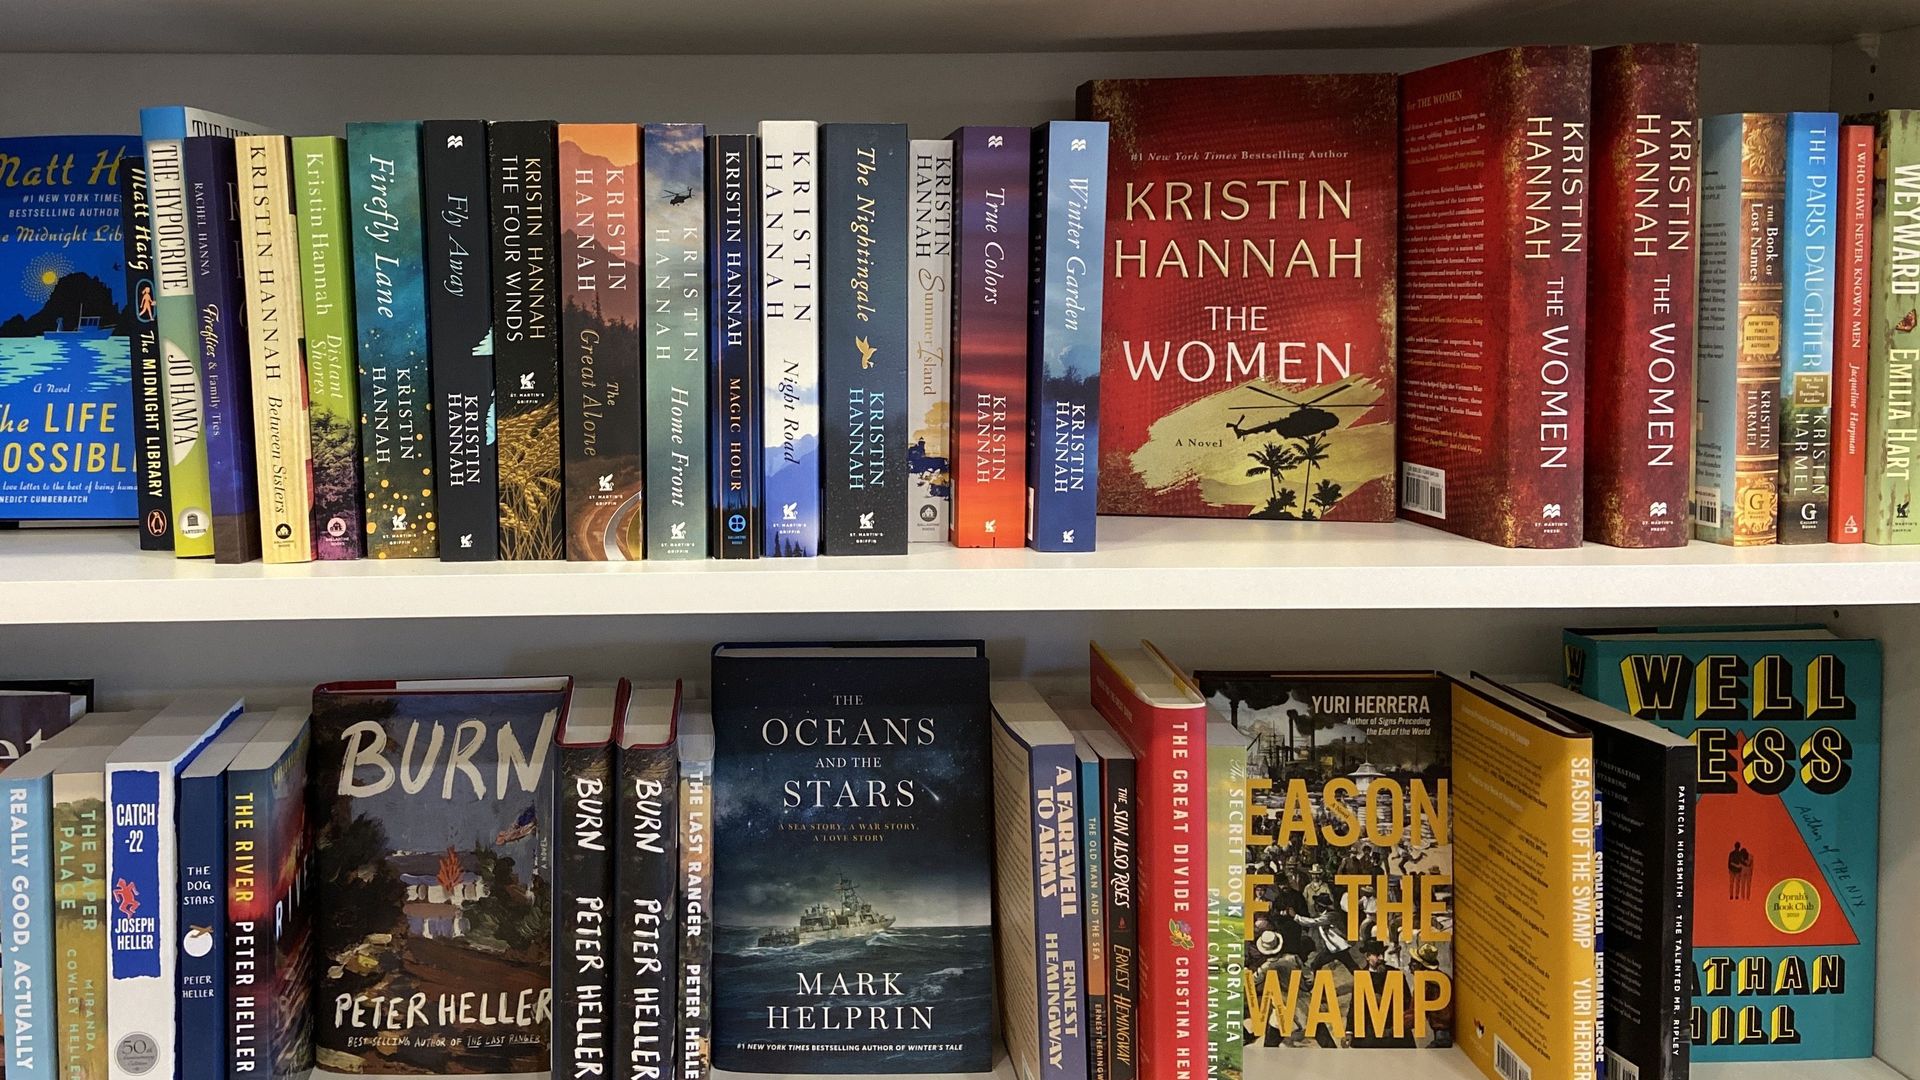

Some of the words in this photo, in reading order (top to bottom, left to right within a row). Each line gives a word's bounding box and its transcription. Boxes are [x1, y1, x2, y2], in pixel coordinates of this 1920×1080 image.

[151, 145, 180, 181] THE
[857, 147, 876, 186] The
[1147, 152, 1172, 161] New
[1175, 152, 1200, 161] York
[1203, 151, 1238, 161] Times
[1241, 150, 1305, 161] Bestselling
[1308, 149, 1349, 159] Author
[1808, 127, 1827, 166] THE
[1856, 151, 1866, 184] WHO
[130, 168, 147, 219] Matt
[306, 153, 327, 226] Kristin
[364, 154, 399, 243] Firefly
[502, 155, 519, 194] THE
[524, 158, 543, 237] KRISTIN
[1525, 117, 1553, 259] HANNAH
[1561, 122, 1584, 253] KRISTIN
[9, 208, 75, 218] BESTSELLING
[79, 208, 119, 217] AUTHOR
[441, 194, 469, 228] Fly
[985, 187, 1005, 233] True
[1067, 178, 1089, 250] Winter
[1126, 180, 1351, 221] KRISTIN
[1750, 203, 1763, 232] Lost
[1805, 175, 1827, 238] PARIS
[1855, 188, 1865, 220] HAVE
[16, 225, 88, 248] Midnight
[129, 225, 152, 271] Haig
[156, 187, 189, 290] HYPOCRITE
[503, 205, 521, 262] FOUR
[765, 153, 784, 319] HANNAH
[793, 151, 811, 322] KRISTIN
[1766, 227, 1778, 259] Book
[1854, 222, 1864, 265] NEVER
[1891, 163, 1920, 294] WEYWARD
[311, 233, 333, 316] Hannah
[444, 233, 470, 298] Away
[850, 194, 876, 322] Nightingale
[984, 241, 1005, 304] Colors
[1114, 238, 1362, 279] HANNAH
[1749, 235, 1762, 282] Names
[375, 253, 400, 319] Lane
[505, 271, 524, 341] WINDS
[527, 247, 545, 339] HANNAH
[1065, 256, 1087, 331] Garden
[1546, 276, 1564, 317] THE
[1802, 245, 1827, 367] DAUGHTER
[1853, 268, 1864, 317] KNOWN
[141, 330, 155, 353] The
[199, 303, 219, 358] Fireflies
[1204, 306, 1269, 331] THE
[1852, 320, 1862, 348] MEN
[311, 339, 325, 396] Shores
[327, 334, 344, 399] Distant
[580, 328, 600, 389] Great
[1122, 340, 1352, 385] WOMEN
[142, 358, 160, 431] MIDNIGHT
[606, 382, 620, 406] The
[729, 378, 741, 433] MAGIC
[778, 359, 800, 410] Night
[1540, 325, 1569, 468] WOMEN
[1848, 362, 1860, 409] Jacqueline
[1887, 348, 1920, 421] EMILIA
[44, 402, 118, 433] LIFE
[170, 383, 199, 445] HAMYA
[267, 396, 283, 458] Between
[583, 394, 603, 457] Alone
[670, 387, 689, 445] Home
[1847, 412, 1859, 455] Harpman
[783, 418, 800, 465] Road
[1188, 438, 1223, 448] Novel
[1886, 428, 1918, 481] HART
[147, 437, 163, 498] LIBRARY
[273, 465, 288, 514] Sisters
[671, 451, 689, 508] Front
[730, 442, 741, 491] HOUR
[833, 695, 864, 706] THE
[1311, 695, 1350, 714] YURI
[1354, 695, 1431, 714] HERRERA
[1620, 653, 1857, 721] WELL
[761, 717, 935, 746] OCEANS
[1172, 721, 1188, 759] THE
[1346, 717, 1368, 725] Author
[1378, 717, 1397, 727] Signs
[1398, 717, 1431, 727] Preceding
[338, 707, 559, 801] BURN
[815, 757, 847, 768] AND
[851, 757, 882, 768] THE
[234, 793, 254, 830] THE
[689, 771, 704, 805] THE
[783, 779, 915, 809] STARS
[1172, 769, 1189, 833] GREAT
[1570, 758, 1590, 829] SEASON
[1676, 786, 1686, 835] PATRICIA
[10, 788, 29, 867] REALLY
[81, 809, 97, 852] THE
[116, 803, 156, 827] CATCH
[575, 777, 606, 852] BURN
[689, 812, 703, 854] LAST
[1088, 818, 1097, 836] THE
[1113, 803, 1129, 844] SUN
[1228, 788, 1244, 857] SECRET
[1571, 829, 1590, 848] OF
[60, 826, 77, 910] PALACE
[187, 865, 211, 876] THE
[235, 841, 254, 903] RIVER
[1038, 824, 1058, 899] ARMS
[1056, 791, 1078, 918] FAREWELL
[1089, 840, 1097, 860] OLD
[1112, 836, 1130, 869] ALSO
[1571, 851, 1591, 883] THE
[1674, 840, 1684, 898] HIGHSMITH
[82, 863, 98, 931] PAPER
[183, 895, 216, 906] STARS
[187, 880, 212, 891] DOG
[687, 862, 703, 938] RANGER
[1090, 864, 1098, 889] MAN
[1110, 869, 1131, 909] RISES
[1173, 844, 1190, 913] DIVIDE
[1227, 864, 1243, 917] BOOK
[1778, 892, 1809, 902] Oprah's
[10, 875, 31, 953] GOOD,
[115, 918, 155, 934] JOSEPH
[1091, 893, 1099, 916] AND
[1091, 919, 1100, 938] THE
[1335, 873, 1453, 942] THE
[1571, 886, 1592, 949] SWAMP
[1674, 914, 1683, 936] THE
[1773, 902, 1794, 911] Book
[1795, 902, 1815, 911] Club
[117, 935, 154, 951] HELLER
[575, 896, 604, 974] PETER
[1092, 940, 1101, 961] SEA
[796, 972, 905, 996] MARK
[1113, 943, 1131, 991] ERNEST
[1226, 943, 1242, 1001] FLORA
[1673, 939, 1682, 992] TALENTED
[14, 959, 33, 1070] ACTUALLY
[335, 991, 430, 1030] PETER
[438, 988, 552, 1028] HELLER
[766, 1005, 935, 1031] HELPRIN
[1572, 977, 1592, 1017] YURI
[574, 985, 604, 1079] HELLER
[747, 1043, 765, 1051] NEW
[767, 1043, 787, 1052] YORK
[788, 1043, 810, 1052] TIMES
[811, 1043, 861, 1052] BESTSELLING
[862, 1043, 894, 1052] AUTHOR
[908, 1043, 944, 1052] WINTER'S
[946, 1043, 963, 1051] TALE
[1113, 993, 1132, 1066] HEMINGWAY
[1226, 1010, 1242, 1043] LEA
[1672, 1019, 1681, 1057] RIPLEY
